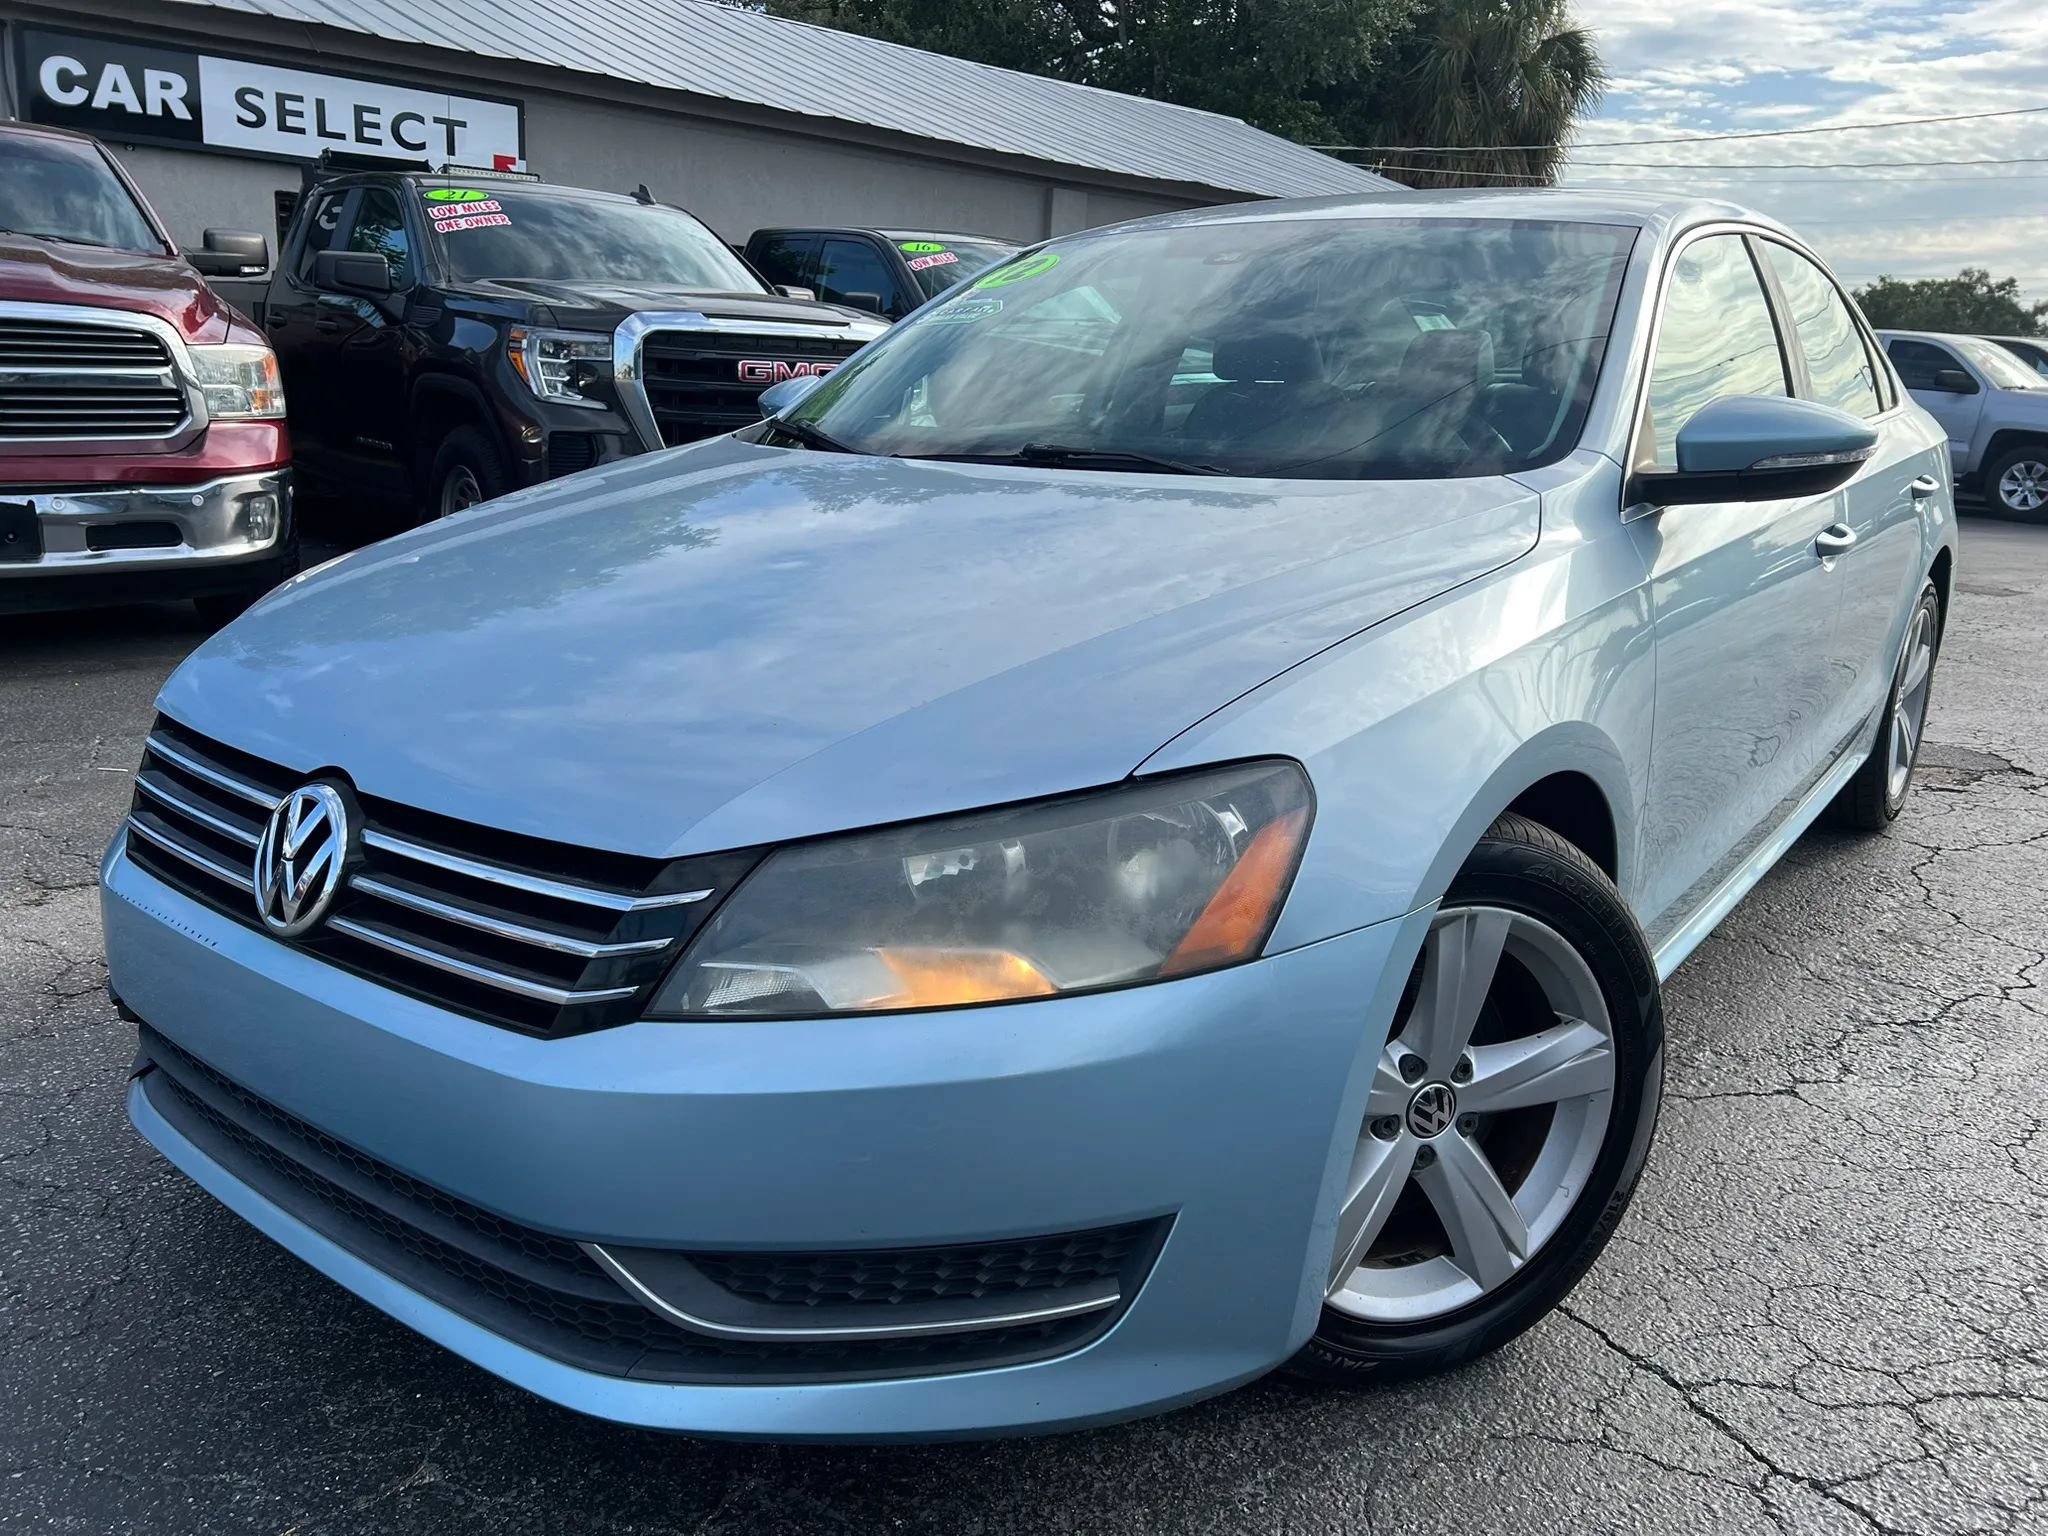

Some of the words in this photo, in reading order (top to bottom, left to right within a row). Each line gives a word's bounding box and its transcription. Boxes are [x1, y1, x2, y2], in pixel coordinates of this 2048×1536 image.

[39, 54, 193, 121] CAR
[235, 86, 468, 157] SELECT
[444, 190, 469, 200] 21
[430, 205, 458, 218] LOW
[461, 201, 501, 213] MILES
[436, 219, 461, 232] ONE
[464, 215, 508, 227] OWNER
[915, 243, 931, 251] 16
[909, 257, 930, 270] LOW
[930, 252, 957, 266] MILES
